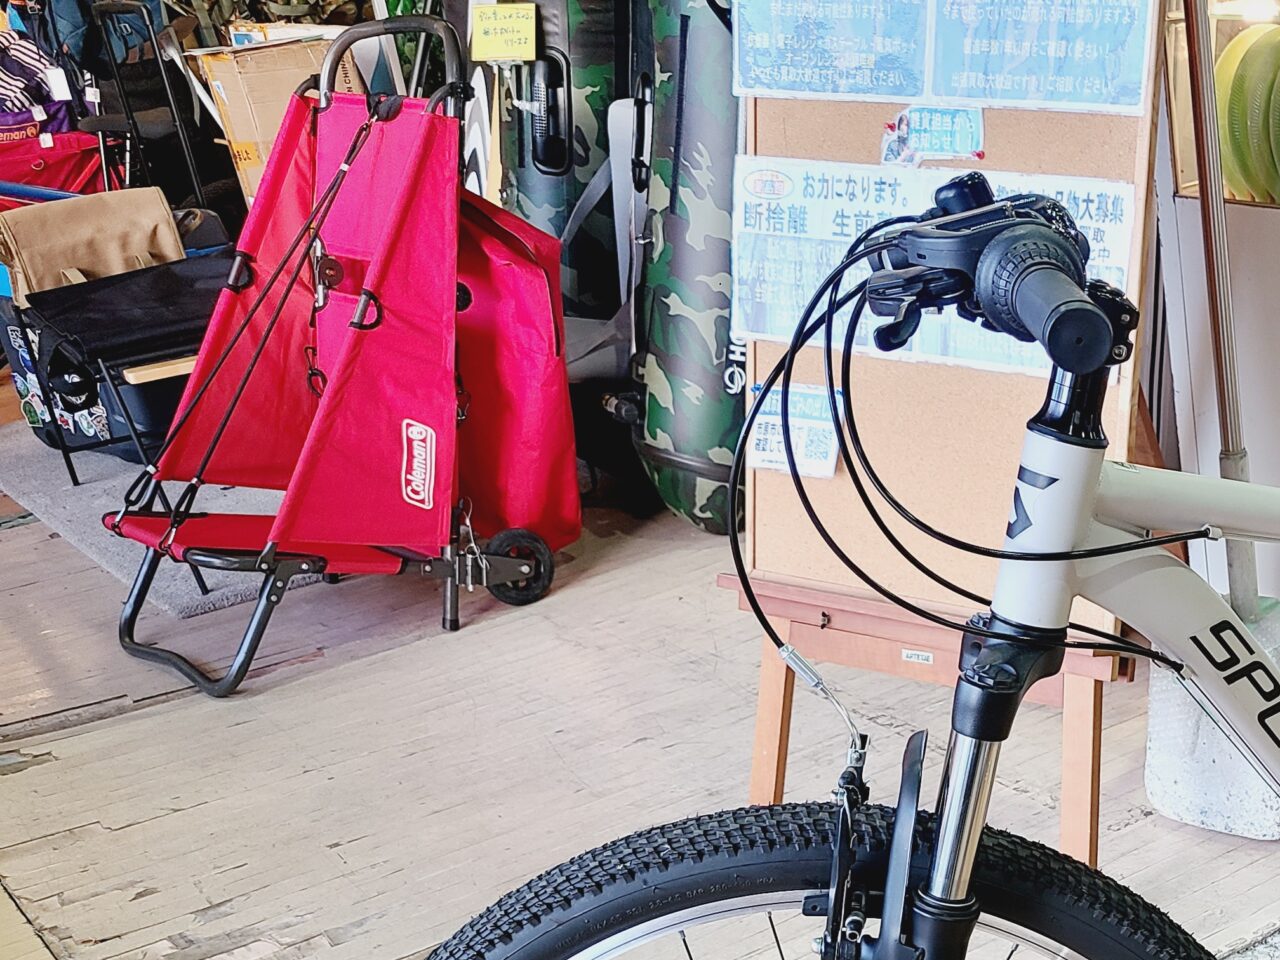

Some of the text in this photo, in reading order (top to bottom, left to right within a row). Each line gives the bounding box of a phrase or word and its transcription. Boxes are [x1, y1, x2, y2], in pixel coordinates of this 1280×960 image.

[744, 202, 808, 235] 断捨離
[406, 440, 427, 501] Coleman
